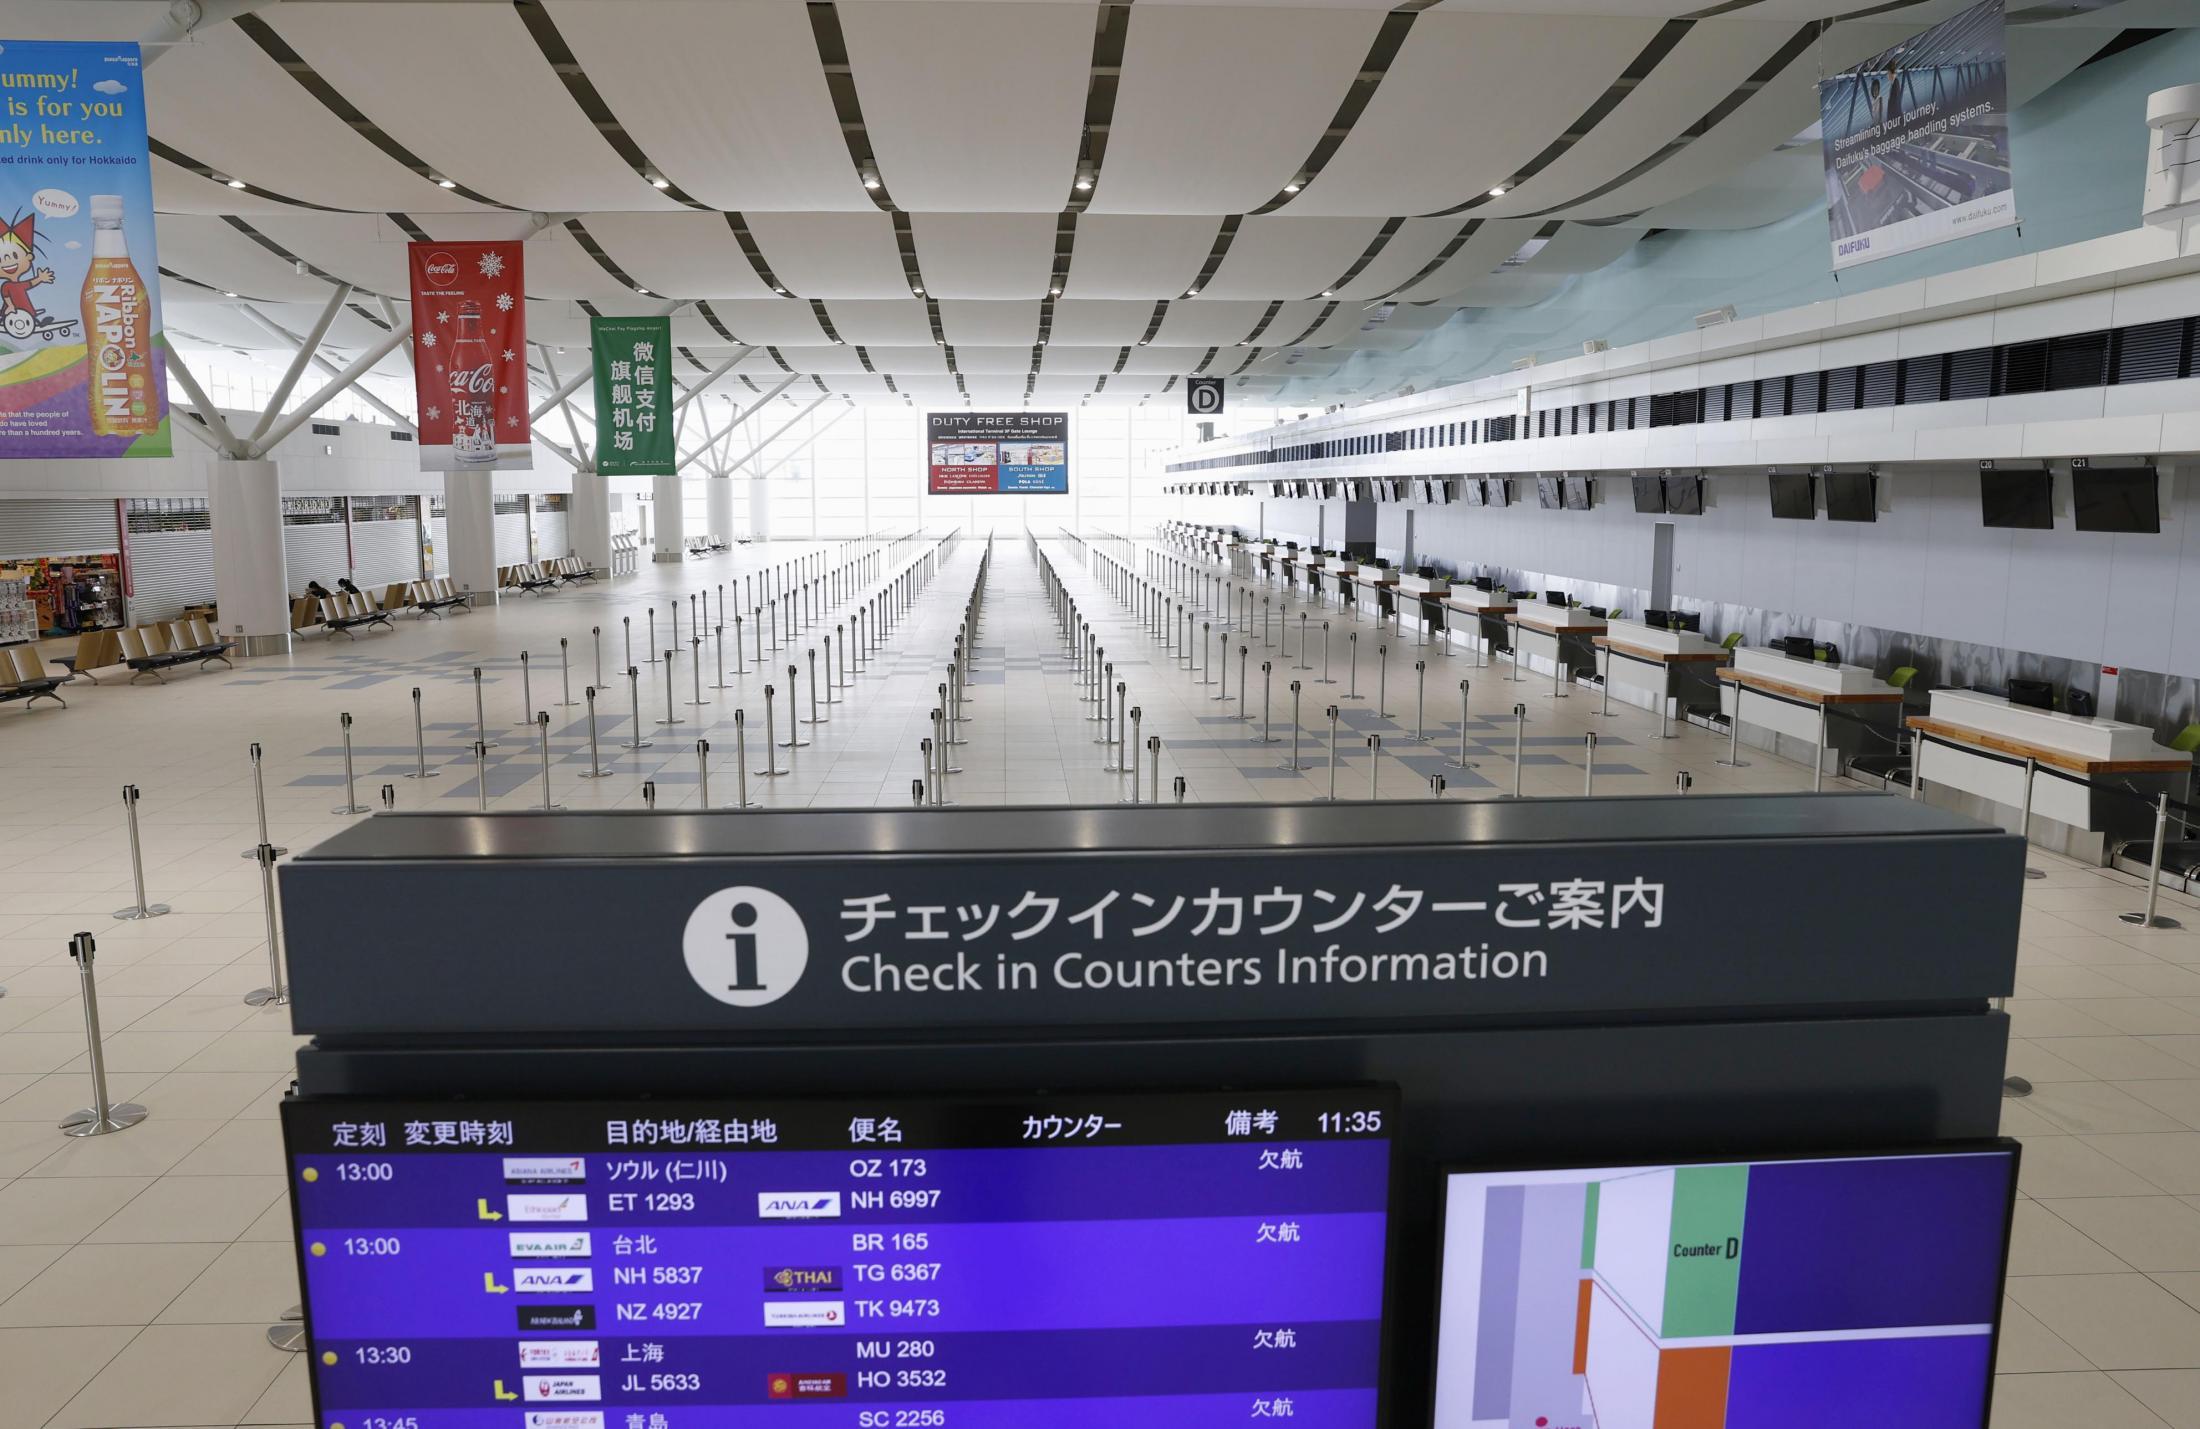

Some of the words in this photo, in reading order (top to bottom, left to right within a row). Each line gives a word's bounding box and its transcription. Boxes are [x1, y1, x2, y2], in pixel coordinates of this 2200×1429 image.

[1, 68, 78, 92] ummy!
[8, 97, 28, 116] is
[37, 95, 72, 116] for
[81, 102, 123, 121] you
[0, 123, 32, 148] nly
[41, 123, 102, 144] here.
[1835, 124, 1880, 151] Streamlining
[1883, 117, 1901, 133] your
[1902, 101, 1939, 125] journey.
[1836, 147, 1869, 169] Daifuku's
[1871, 135, 1906, 156] baggage
[1908, 118, 1947, 142] handling
[1950, 101, 1994, 127] systems.
[17, 155, 44, 164] drink
[46, 155, 69, 166] only
[71, 155, 86, 164] for
[89, 155, 137, 164] Hokkaido
[37, 195, 78, 212] Yummy!
[1952, 203, 2008, 225] www.daifuku.com
[1838, 237, 1870, 256] DAIFUKU
[121, 284, 139, 349] Ribbon
[93, 284, 130, 416] NAPOLIN
[633, 341, 656, 433] 微信支付
[610, 360, 634, 451] 旗舰机场
[1198, 389, 1216, 409] D
[932, 417, 971, 426] DUTY
[977, 417, 1014, 426] FREE
[1020, 417, 1063, 426] SHOP
[1980, 460, 1993, 469] C20
[2072, 459, 2086, 468] C21
[840, 876, 1665, 942] チェックインカウンターご案内
[841, 951, 982, 992] Check
[997, 952, 1037, 990] in
[1053, 951, 1262, 989] Counters
[1278, 942, 1548, 984] Information
[606, 1118, 778, 1145] 目的地/経由地
[848, 1116, 902, 1143] 便名
[1022, 1113, 1122, 1139] カウンター
[1224, 1109, 1279, 1136] 備考
[1318, 1110, 1381, 1133] 11:35
[332, 1121, 386, 1147] 定刻
[404, 1119, 514, 1146] 変更時刻
[849, 1159, 883, 1178] OZ
[889, 1158, 927, 1177] 173
[1258, 1148, 1303, 1170] 欠航
[336, 1162, 393, 1181] 13:00
[606, 1159, 660, 1181] ソウル
[665, 1159, 728, 1184] (仁川)
[608, 1193, 638, 1212] ET
[644, 1192, 695, 1211] 1293
[765, 1200, 809, 1210] ANA
[851, 1190, 884, 1209] NH
[889, 1189, 941, 1209] 6997
[852, 1233, 885, 1252] BR
[891, 1232, 929, 1251] 165
[1256, 1221, 1301, 1243] 欠航
[344, 1237, 401, 1256] 13:00
[612, 1234, 658, 1256] 台北
[1673, 1243, 1722, 1257] Counter
[1726, 1237, 1739, 1259] D
[521, 1275, 562, 1285] ANA
[613, 1267, 647, 1285] NH
[652, 1266, 703, 1285] 5837
[794, 1271, 832, 1284] THAI
[852, 1264, 885, 1282] TG
[890, 1263, 941, 1281] 6367
[616, 1303, 648, 1321] NZ
[652, 1302, 703, 1320] 4927
[854, 1300, 884, 1318] TK
[889, 1299, 940, 1317] 9473
[1253, 1328, 1297, 1349] 欠航
[355, 1346, 411, 1364] 13:30
[620, 1342, 665, 1363] 上海
[856, 1341, 891, 1359] MU
[897, 1340, 935, 1358] 280
[621, 1374, 646, 1392] JL
[650, 1373, 701, 1391] 5633
[857, 1370, 891, 1388] HO
[897, 1369, 946, 1387] 3532
[1251, 1397, 1294, 1418] 欠航
[363, 1417, 419, 1429] 13:45
[859, 1410, 890, 1428] SC
[895, 1409, 945, 1427] 2256
